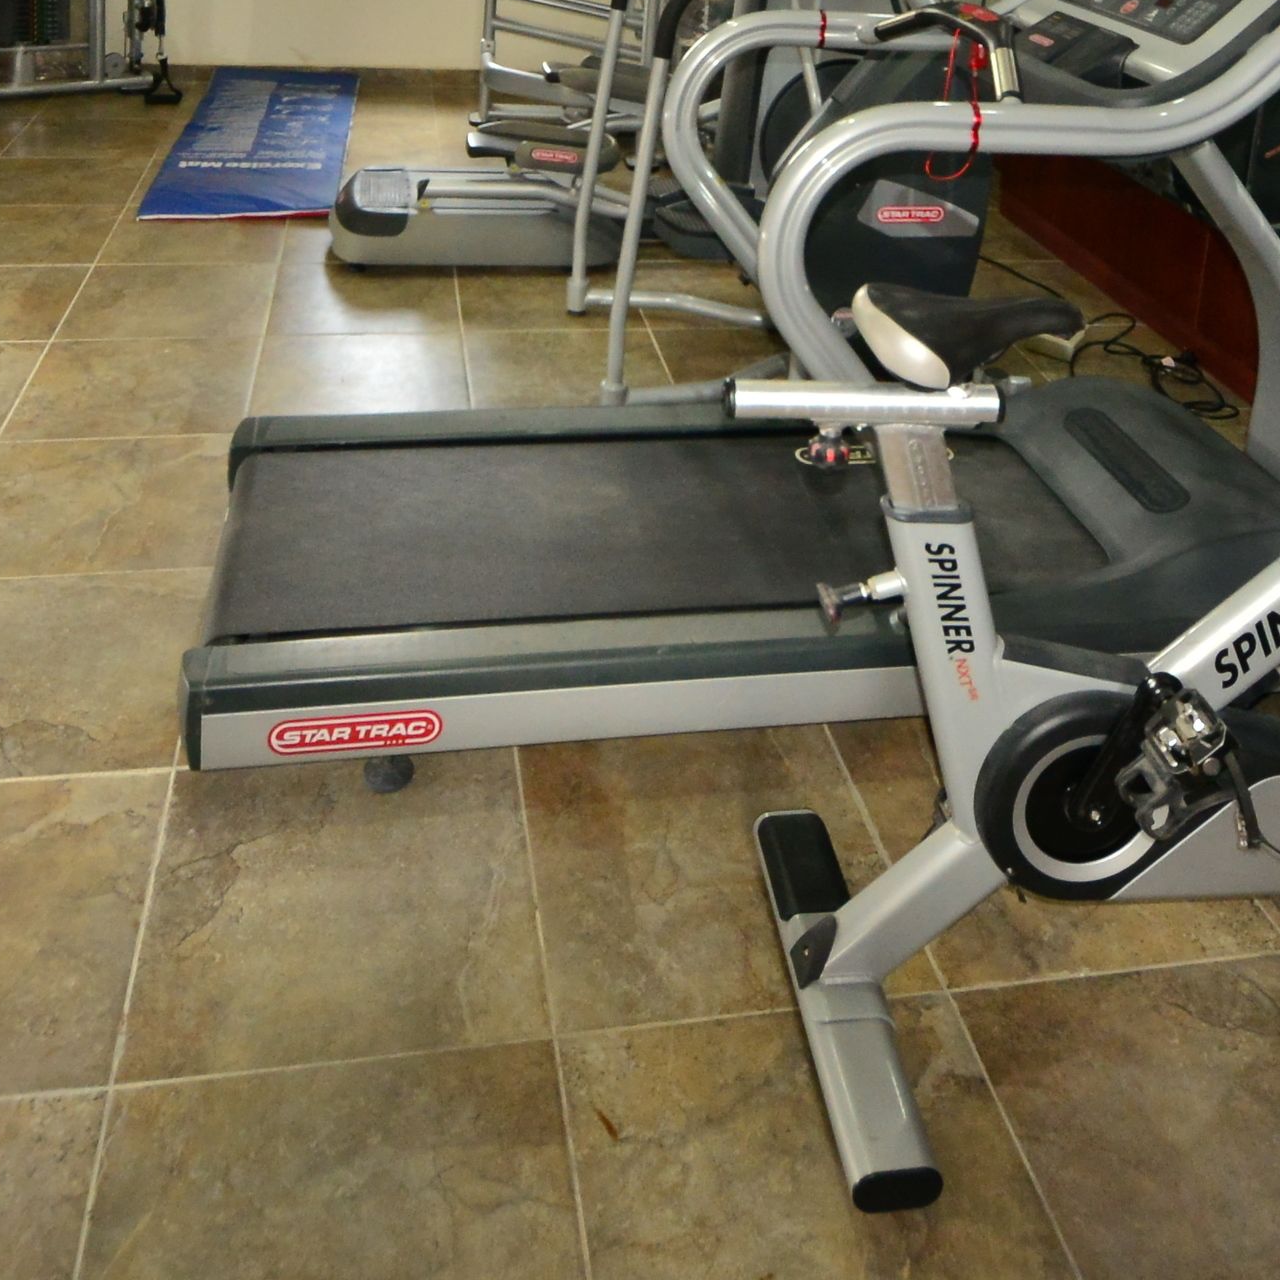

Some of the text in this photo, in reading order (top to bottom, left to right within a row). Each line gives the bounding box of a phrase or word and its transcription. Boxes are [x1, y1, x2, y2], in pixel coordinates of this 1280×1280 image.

[924, 542, 976, 655] SPINNER
[278, 721, 428, 746] STAR TRAC
